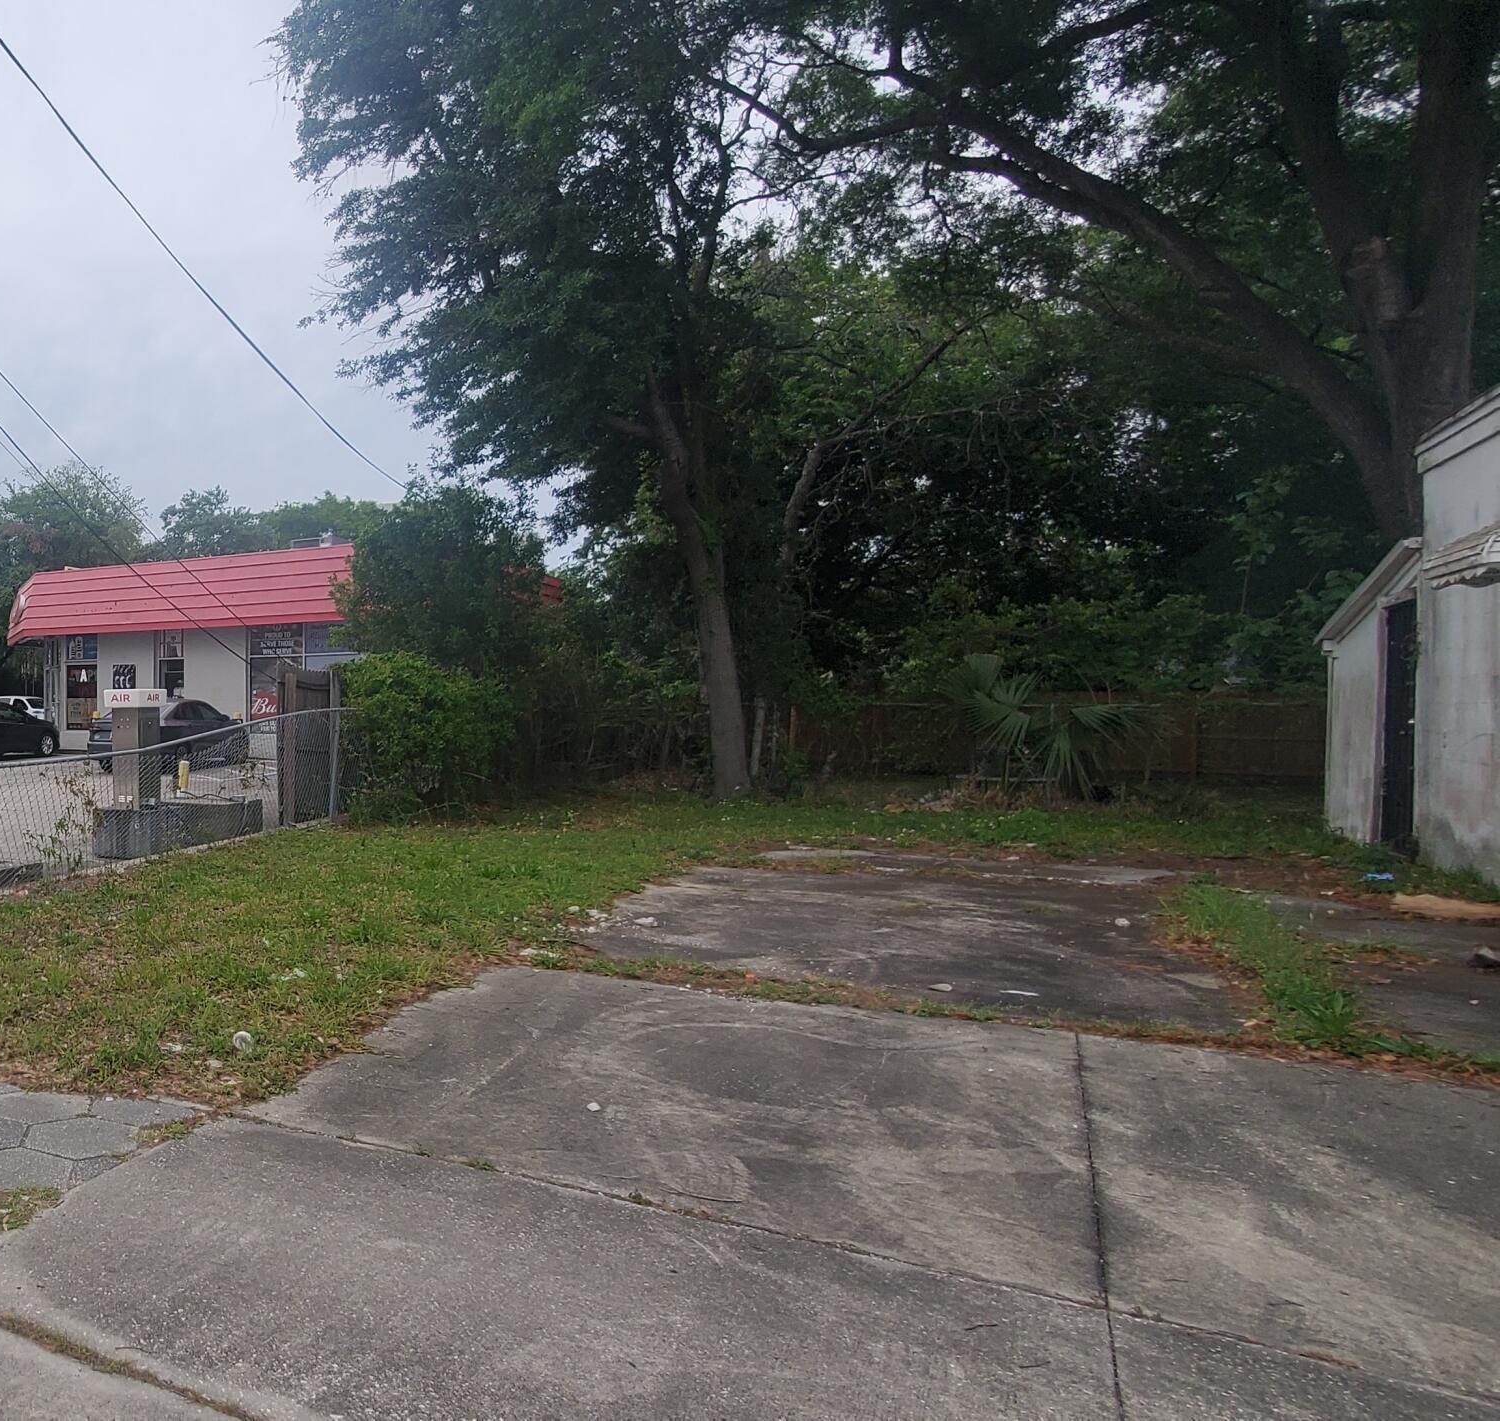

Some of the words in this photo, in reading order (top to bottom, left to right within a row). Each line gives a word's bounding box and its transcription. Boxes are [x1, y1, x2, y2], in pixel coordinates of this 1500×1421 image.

[111, 693, 131, 703] AIR
[147, 693, 160, 702] AIR
[251, 697, 277, 714] Bu
